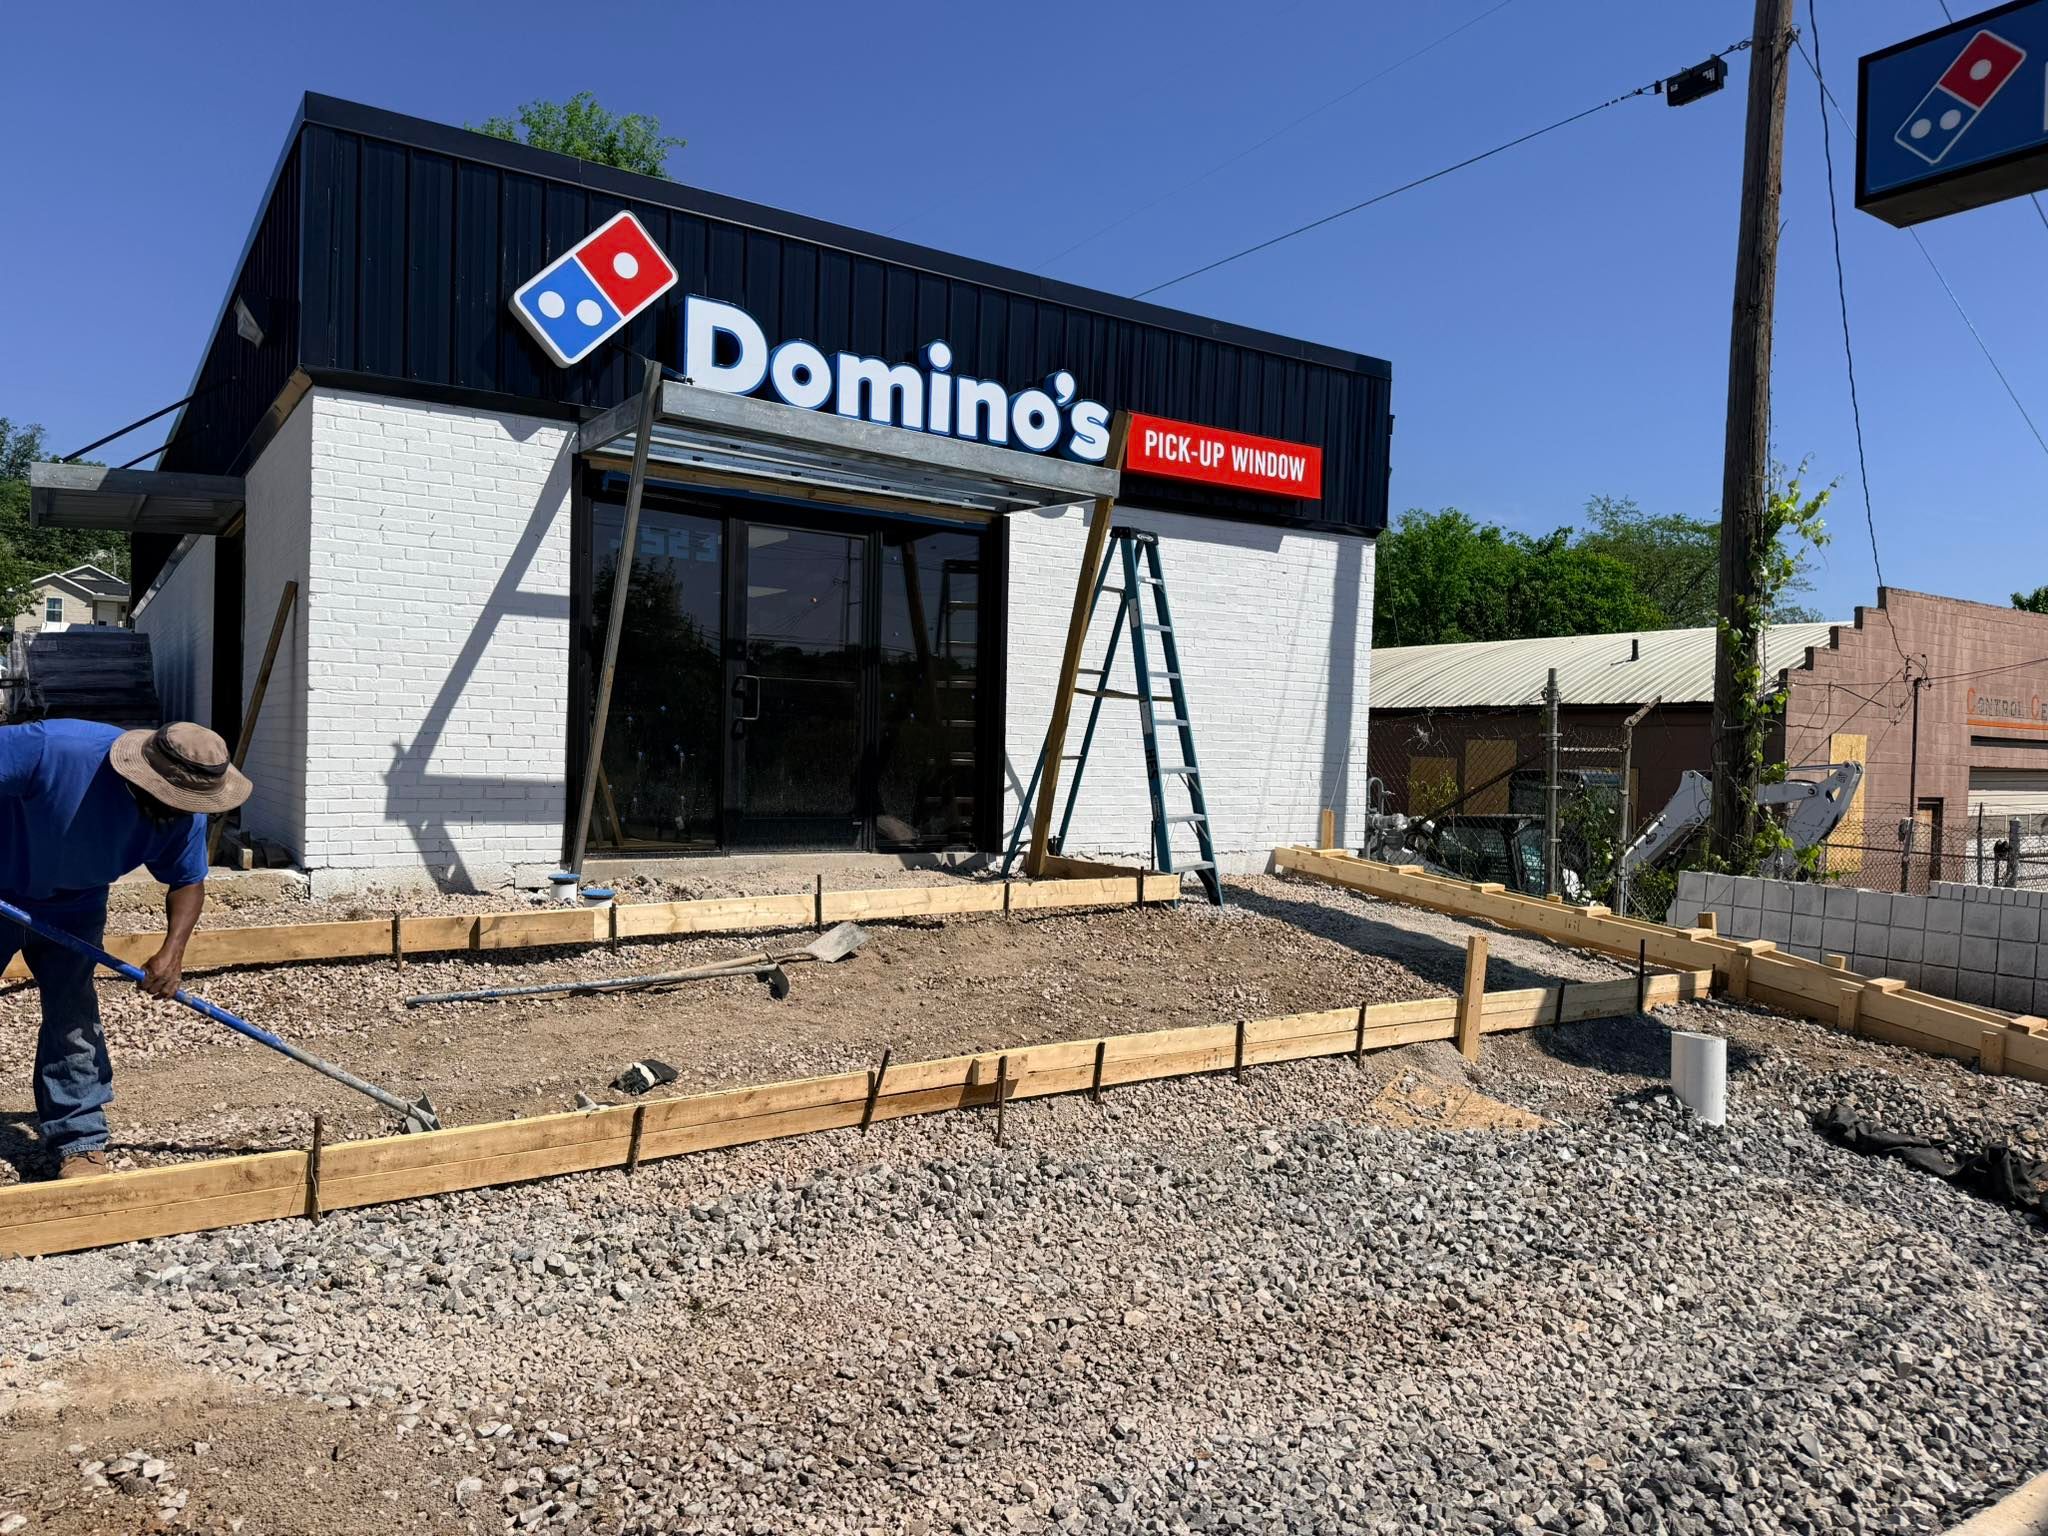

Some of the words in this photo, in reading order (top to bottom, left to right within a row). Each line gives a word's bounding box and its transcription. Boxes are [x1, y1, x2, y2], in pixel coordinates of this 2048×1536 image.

[684, 293, 1112, 462] Domino's
[1144, 429, 1225, 468] PICK-UP
[1231, 445, 1306, 482] WINDOW
[1967, 687, 2025, 717] CONTROL
